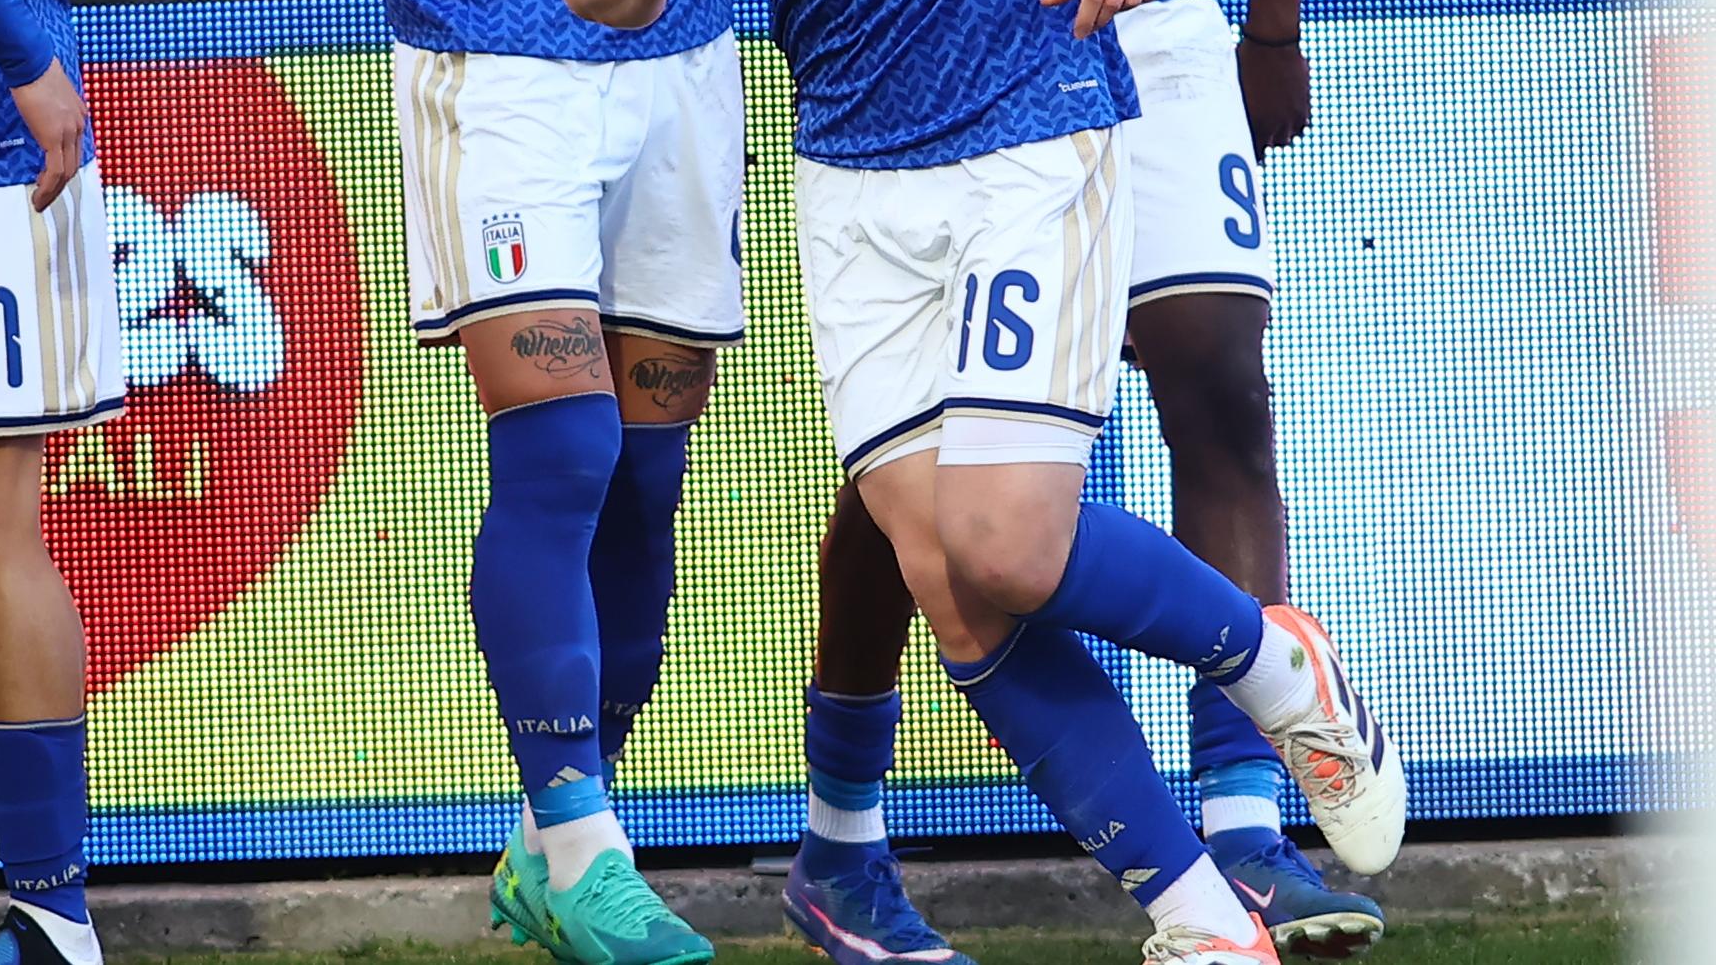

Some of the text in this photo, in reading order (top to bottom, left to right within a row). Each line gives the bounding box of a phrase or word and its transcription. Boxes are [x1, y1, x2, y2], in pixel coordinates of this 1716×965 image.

[1219, 153, 1261, 250] 9
[485, 226, 520, 242] ITALIA
[957, 269, 1040, 373] 16
[516, 715, 594, 734] ITALIA
[14, 862, 81, 891] ITALIA
